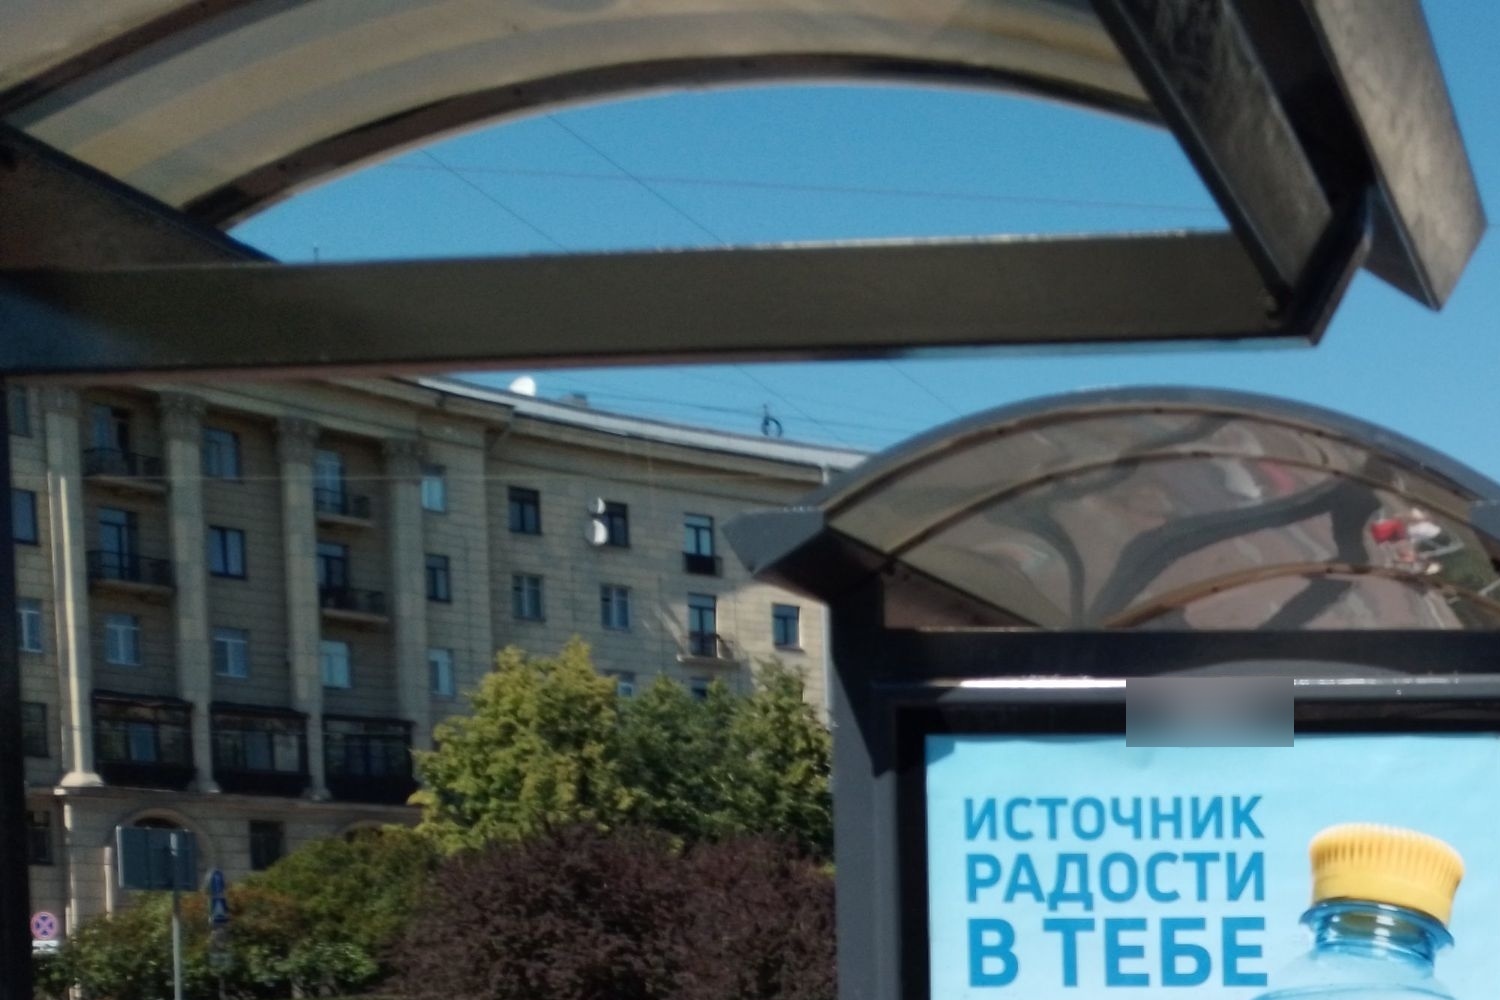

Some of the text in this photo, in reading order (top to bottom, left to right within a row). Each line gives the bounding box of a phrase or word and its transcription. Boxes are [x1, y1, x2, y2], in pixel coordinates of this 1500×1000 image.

[963, 795, 1265, 841] ИСТОЧНИК
[965, 851, 1266, 912] РАДОСТИ
[967, 916, 1268, 988] В ТЕБЕ
